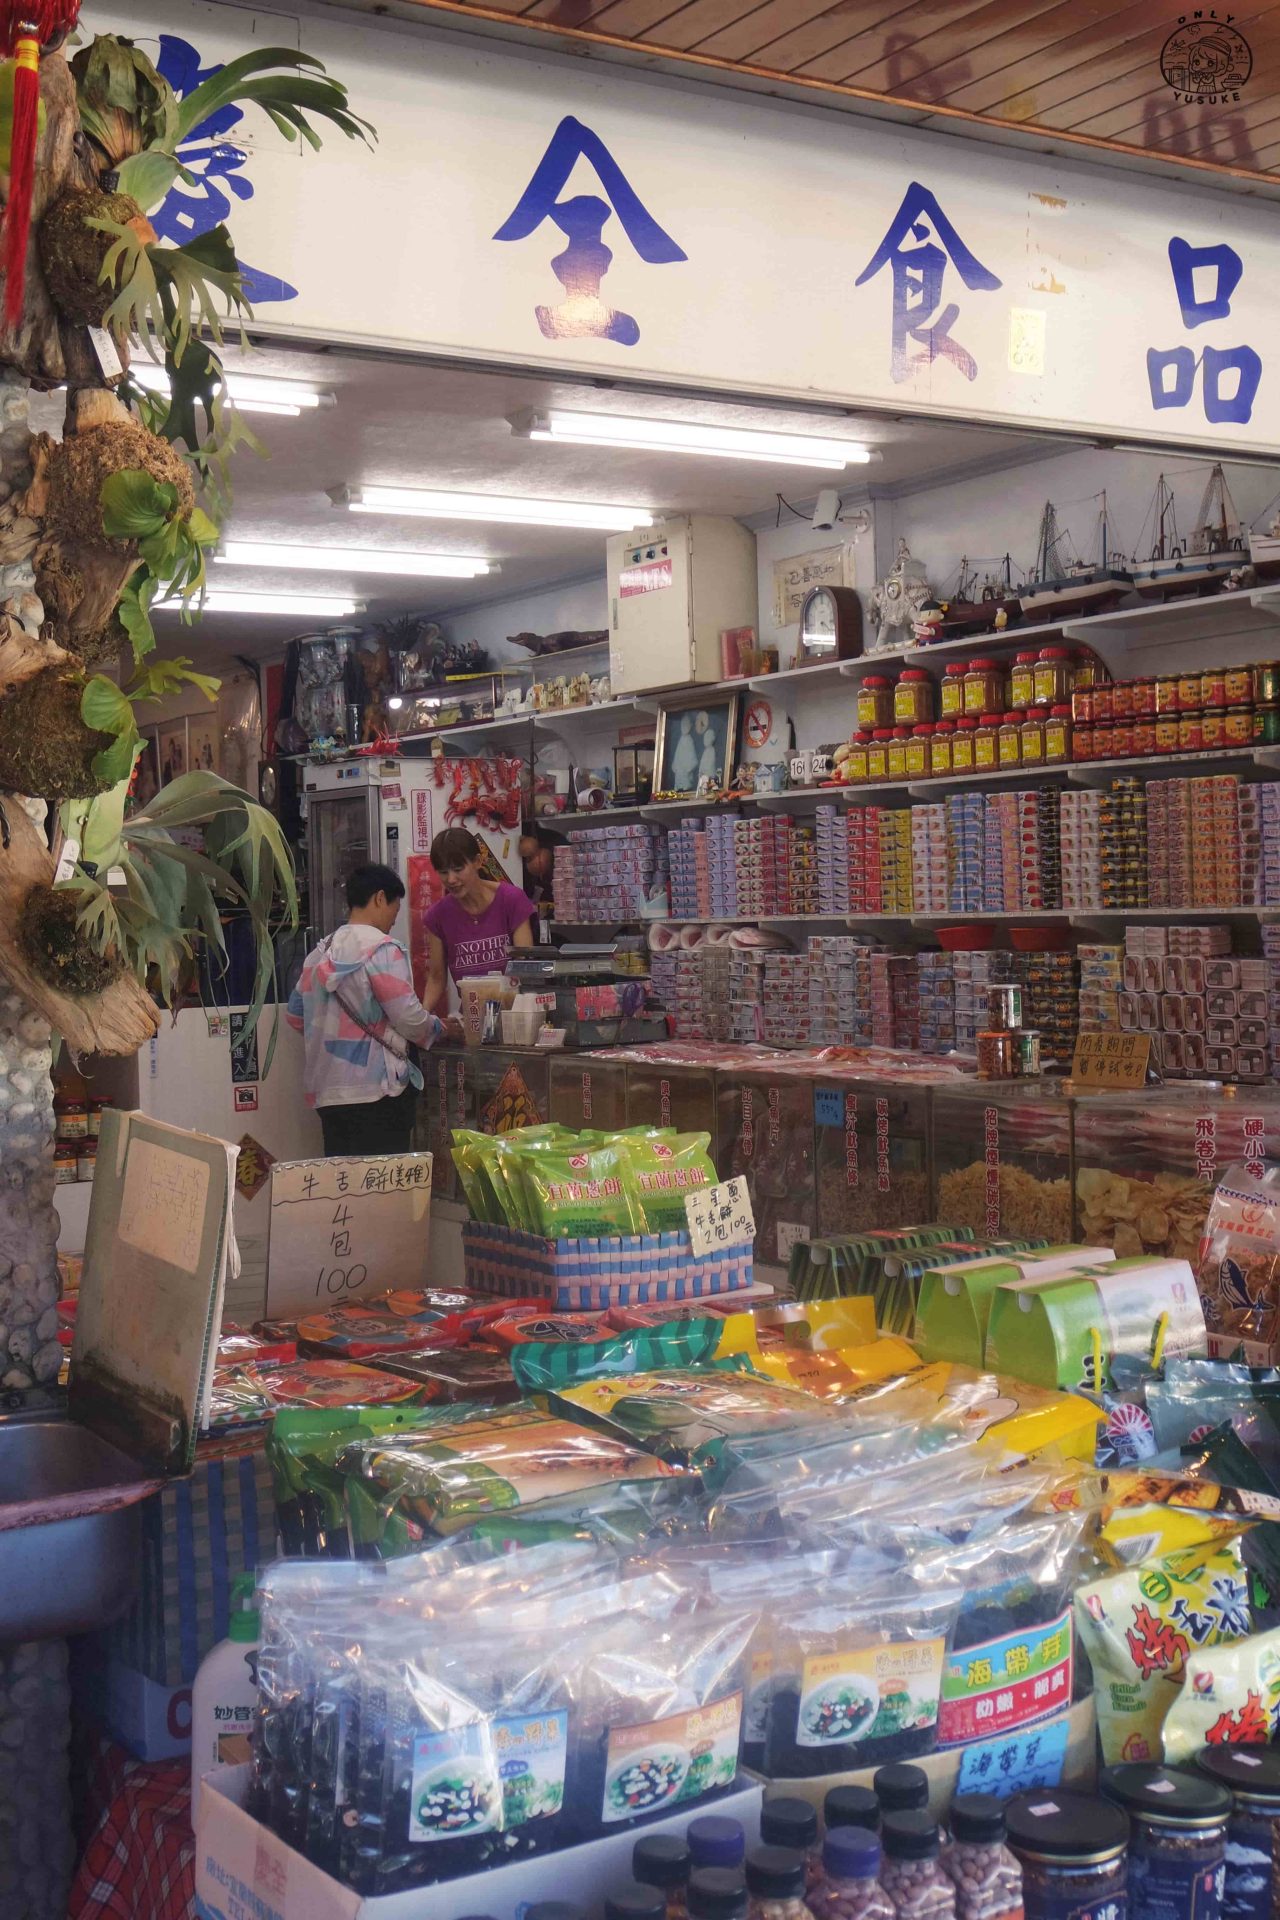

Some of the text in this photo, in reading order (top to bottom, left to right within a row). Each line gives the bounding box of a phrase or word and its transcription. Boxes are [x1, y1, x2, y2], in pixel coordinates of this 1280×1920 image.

[416, 792, 429, 850] 錄影監視中
[768, 1087, 779, 1142] 香魚片
[237, 1149, 264, 1187] 春
[1194, 1117, 1217, 1182] 飛卷片
[1242, 1117, 1265, 1181] 硬小卷
[332, 1203, 354, 1227] 4
[330, 1231, 353, 1258] 包
[315, 1263, 368, 1297] 100
[967, 1632, 1062, 1688] 海帶芽
